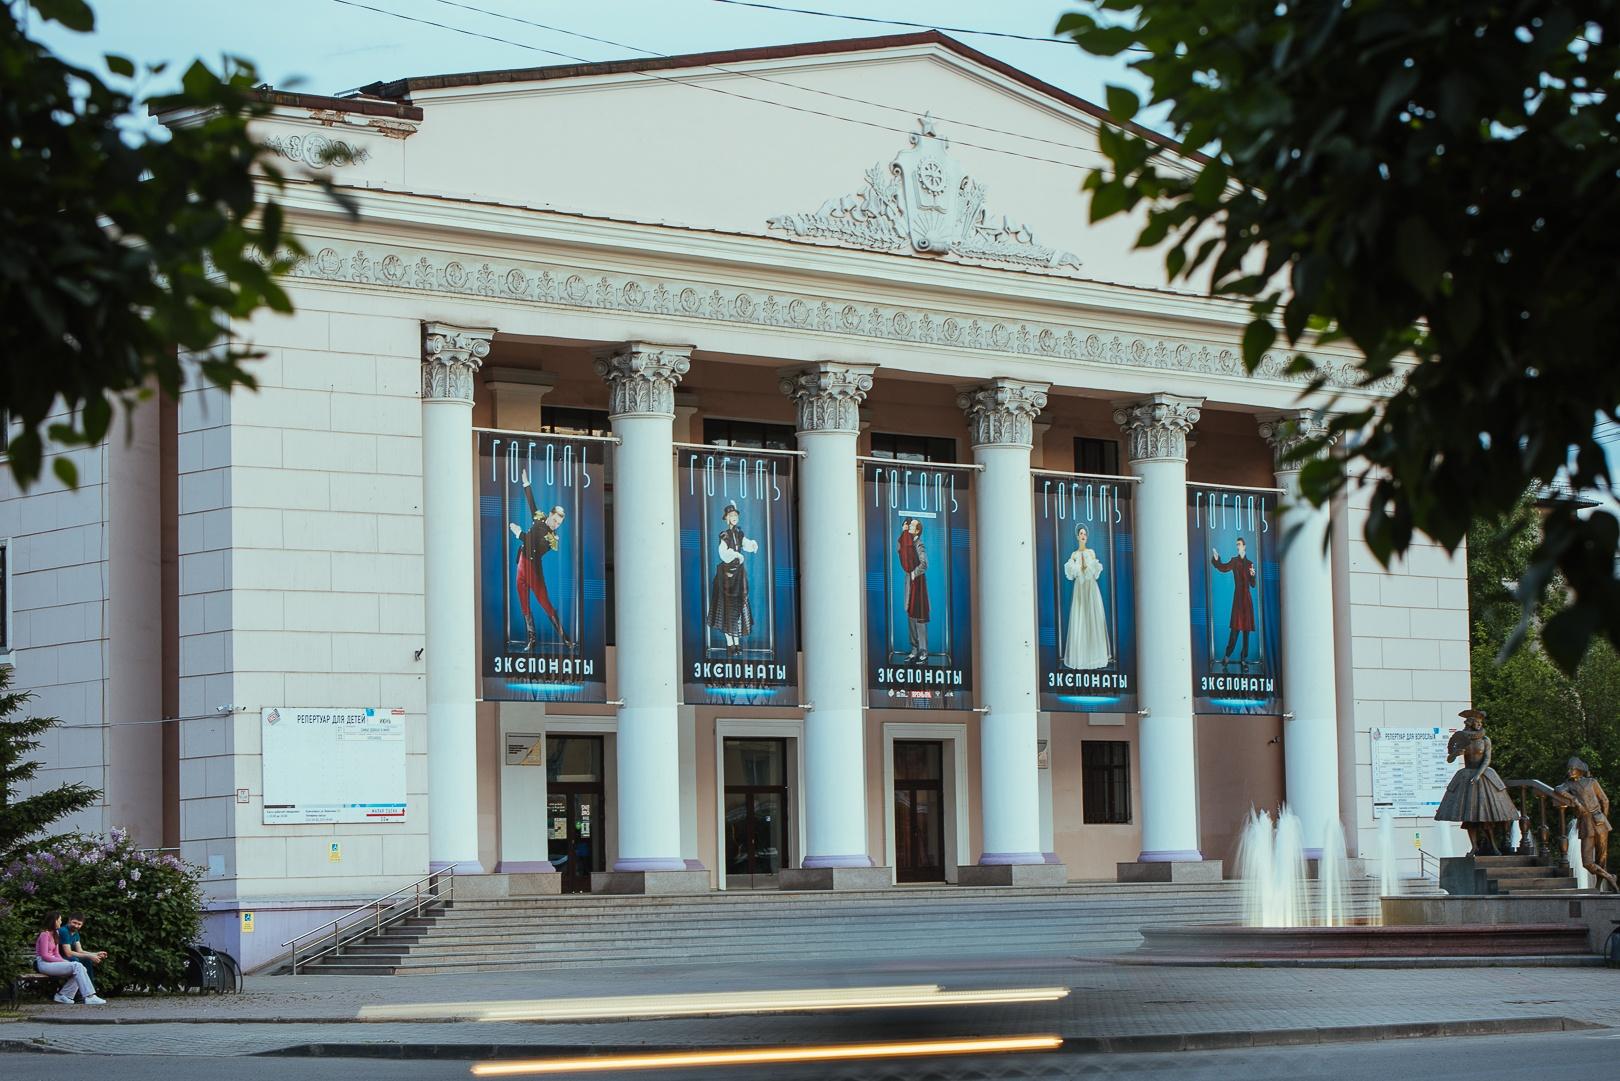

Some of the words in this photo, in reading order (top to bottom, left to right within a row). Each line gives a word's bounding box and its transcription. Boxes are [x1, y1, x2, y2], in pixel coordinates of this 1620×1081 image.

[492, 439, 591, 488] ГОГОЛЬ
[690, 454, 781, 501] ГОГОЛЬ
[875, 468, 958, 513] ГОГОЛЬ
[1043, 480, 1122, 524] ГОГОЛЬ
[1196, 491, 1269, 533] ГОГОЛЬ
[494, 656, 595, 675] ЭКСПОНАТЫ
[694, 662, 787, 680] ЭКСПОНАТЫ
[878, 668, 963, 685] ЭКСПОНАТЫ
[1048, 672, 1129, 689] ЭКСПОНАТЫ
[1201, 676, 1275, 692] ЭКСПОНАТЫ
[297, 714, 330, 724] РЕПЕРТУАР
[332, 715, 345, 725] ДЛЯ
[346, 713, 366, 724] ДЕТЕЙ
